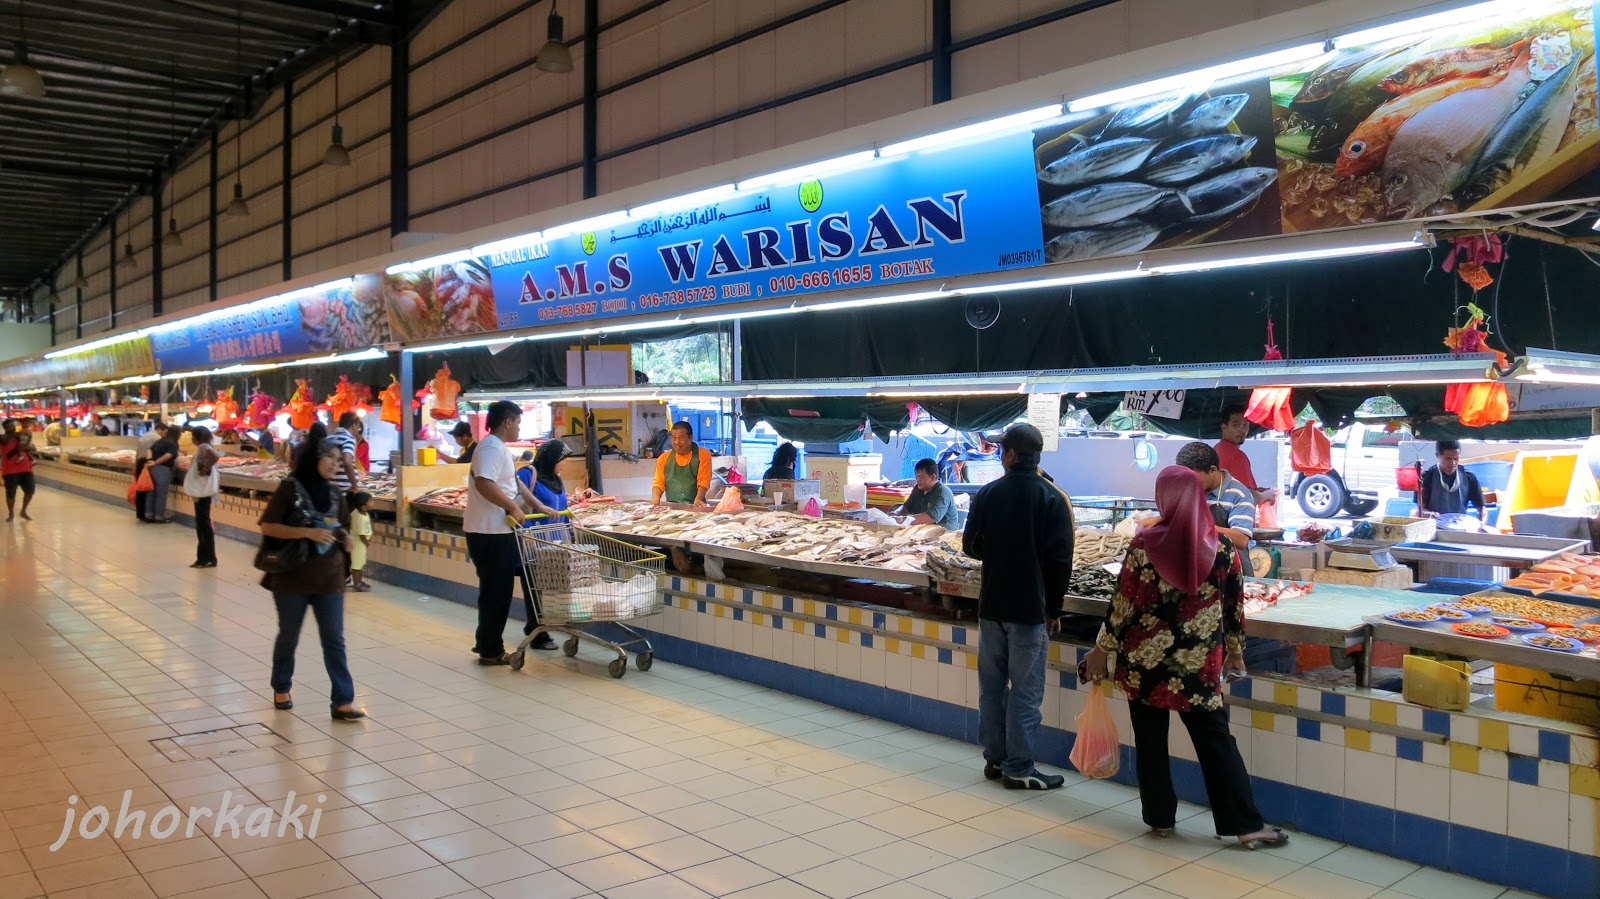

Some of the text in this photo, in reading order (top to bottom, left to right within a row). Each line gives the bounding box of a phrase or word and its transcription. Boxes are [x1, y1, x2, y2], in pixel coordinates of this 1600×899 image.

[491, 240, 550, 268] MENJUAL IKAN
[518, 189, 968, 305] A.M.S WARISAN
[687, 286, 716, 303] 5723
[722, 283, 751, 298] BUDI
[833, 264, 872, 286] 1655
[880, 258, 935, 280] BOTAK
